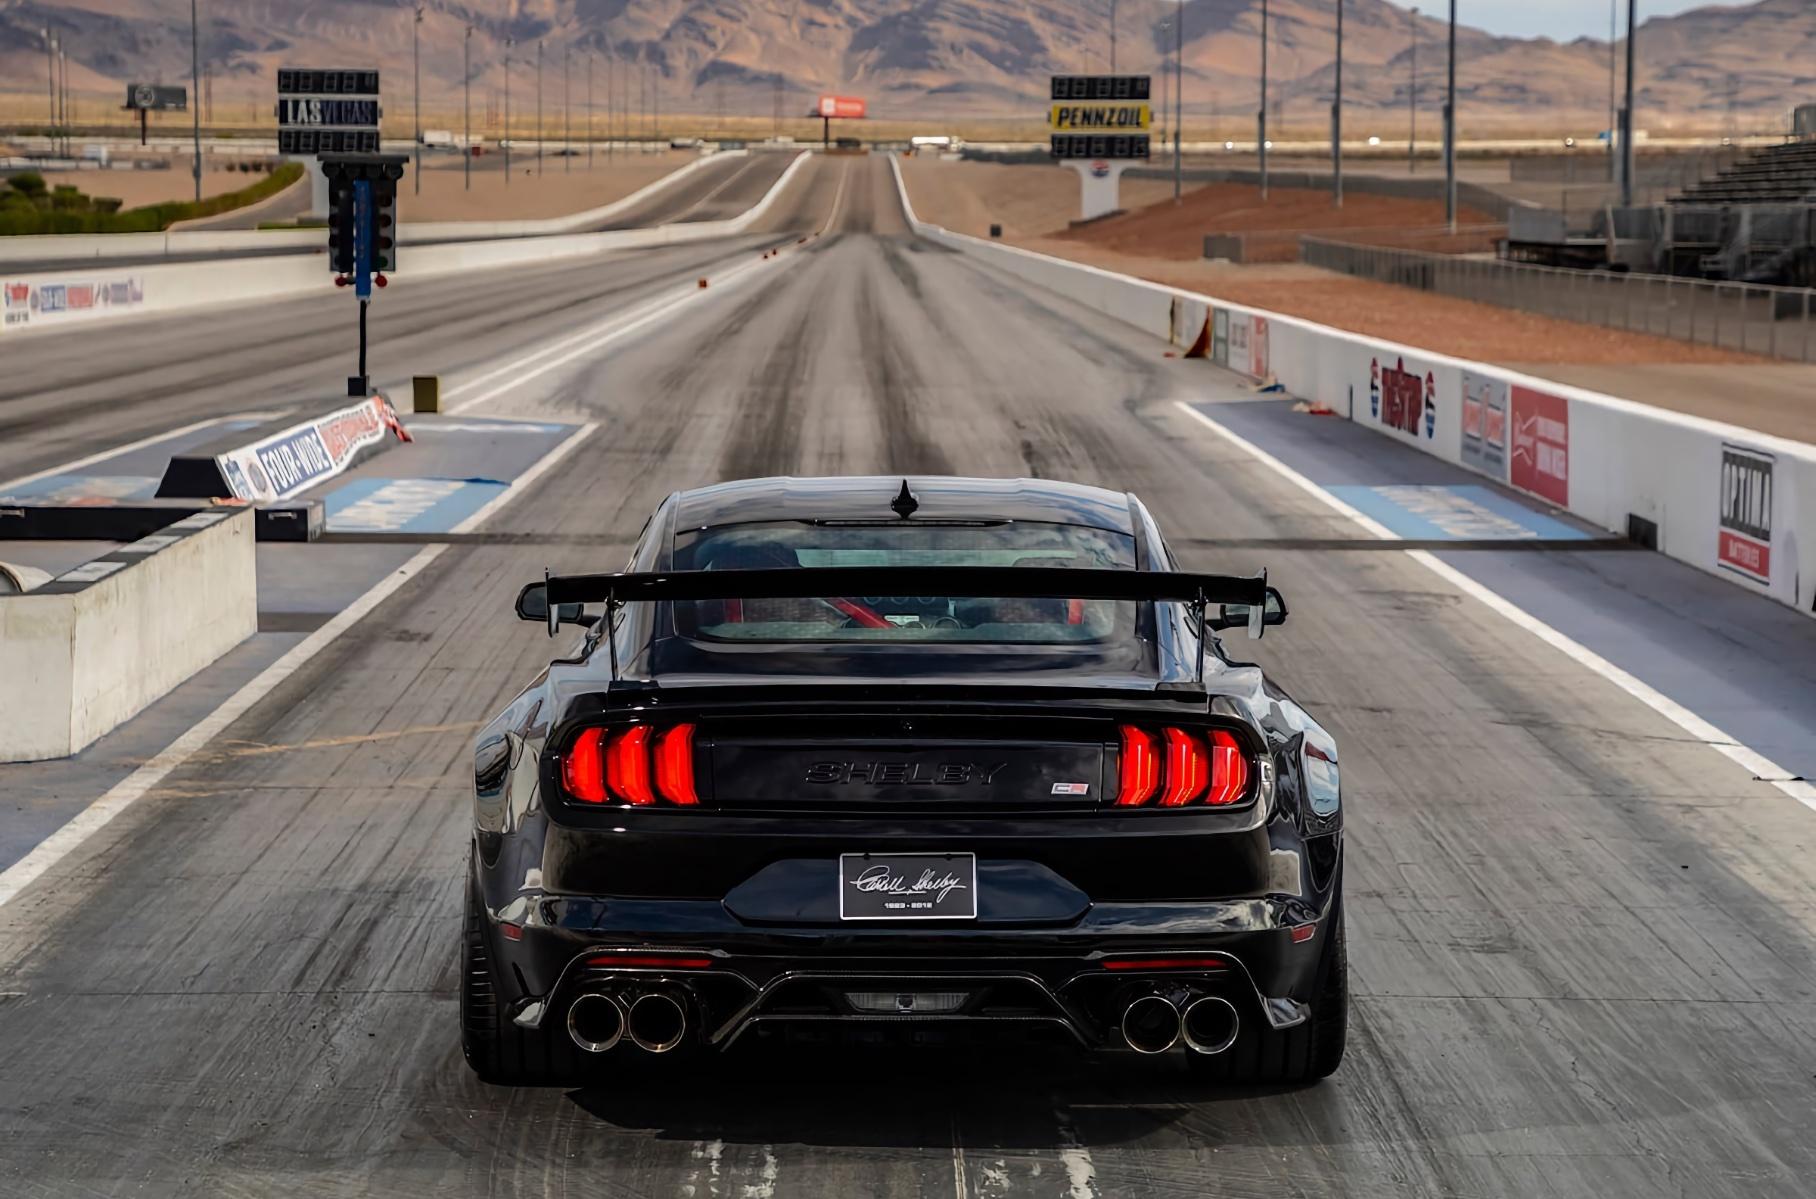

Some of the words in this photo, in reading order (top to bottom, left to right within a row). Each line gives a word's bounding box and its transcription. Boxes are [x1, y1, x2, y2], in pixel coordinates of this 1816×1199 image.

[286, 99, 321, 123] LAS
[1057, 106, 1144, 128] PENNZOIL
[260, 432, 330, 492] FOUR-WIDE
[1721, 461, 1771, 531] OPTIMA
[804, 761, 1008, 786] SHELBY
[911, 868, 967, 903] Shelby
